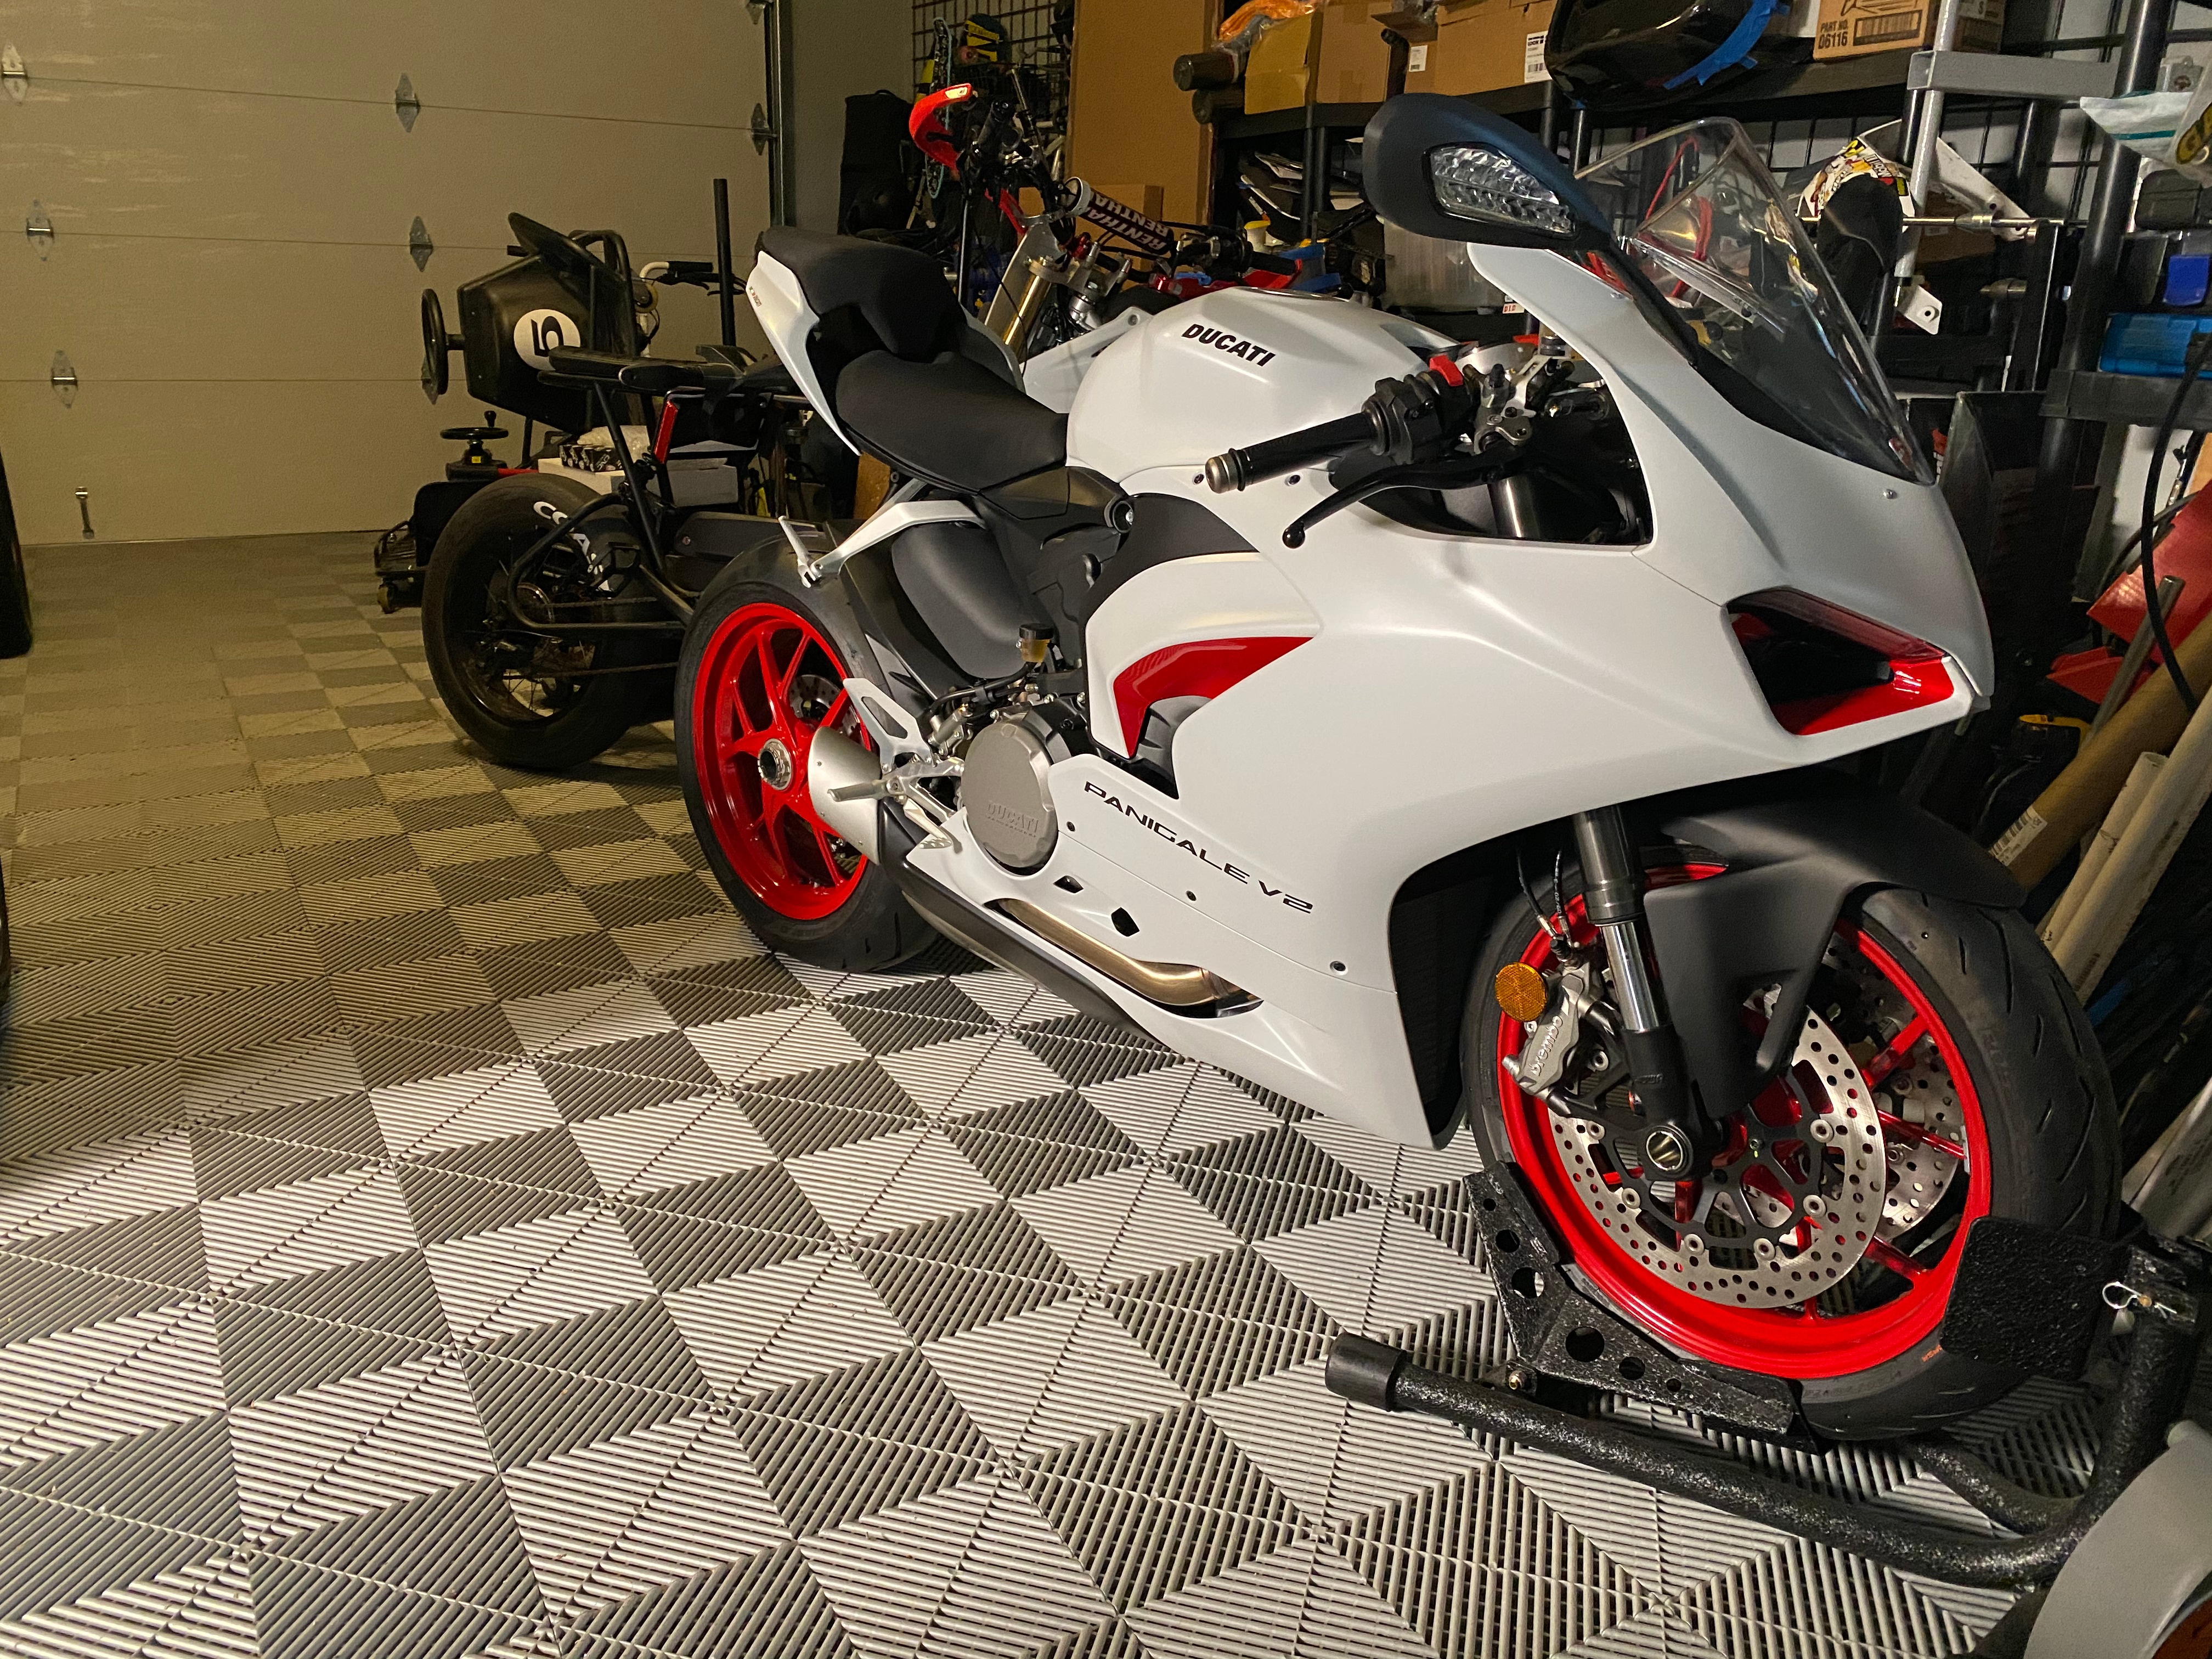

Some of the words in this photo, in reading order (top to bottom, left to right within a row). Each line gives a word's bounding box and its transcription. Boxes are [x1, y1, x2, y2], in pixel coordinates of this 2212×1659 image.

[1818, 31, 1848, 49] 06116
[1820, 20, 1838, 33] PART
[531, 315, 565, 358] 5
[1181, 324, 1276, 367] DUCATI
[1084, 781, 1250, 884] PANIGALE
[1258, 879, 1313, 914] V2
[1528, 1015, 1563, 1076] brembo
